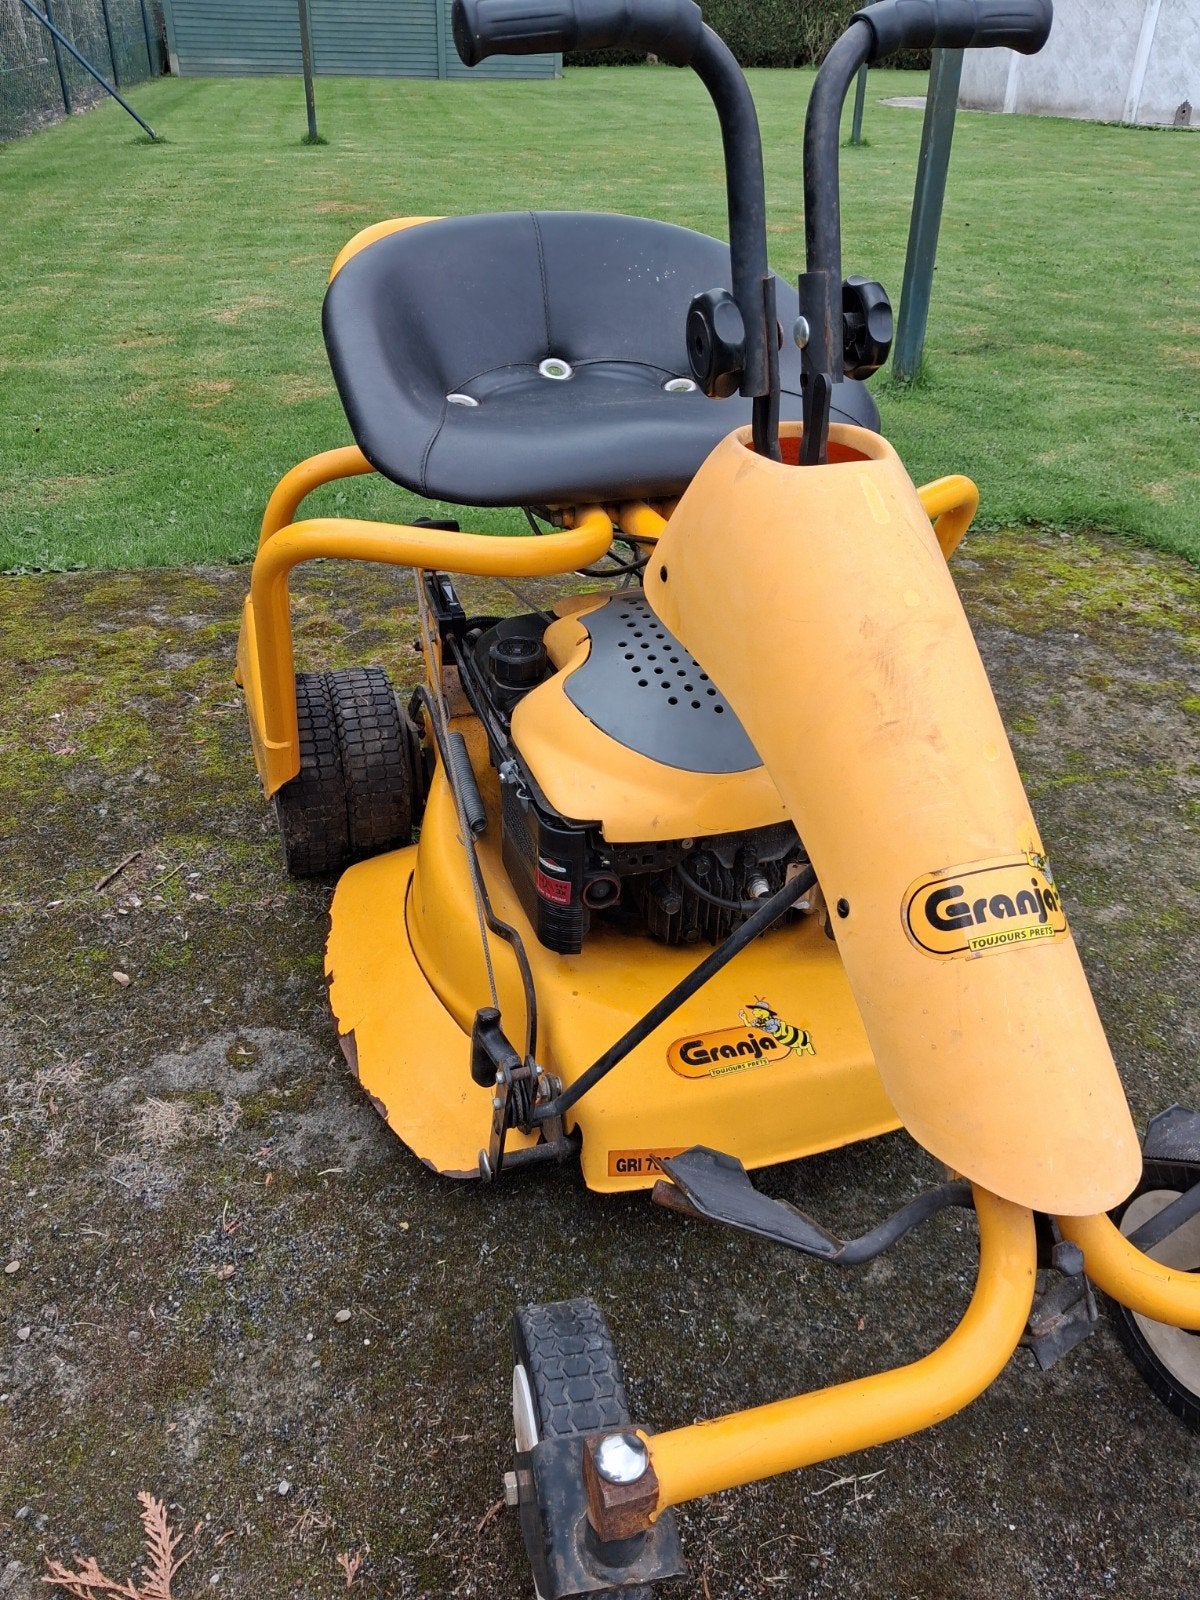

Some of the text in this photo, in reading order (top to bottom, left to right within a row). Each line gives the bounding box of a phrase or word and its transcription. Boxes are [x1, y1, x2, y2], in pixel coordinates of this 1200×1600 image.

[925, 877, 1058, 931] Granja
[972, 926, 1053, 948] TOUJOURS PRETS
[679, 1033, 777, 1066] Granja
[712, 1059, 768, 1075] TOUJOURS PRETS
[616, 1158, 642, 1172] GRI
